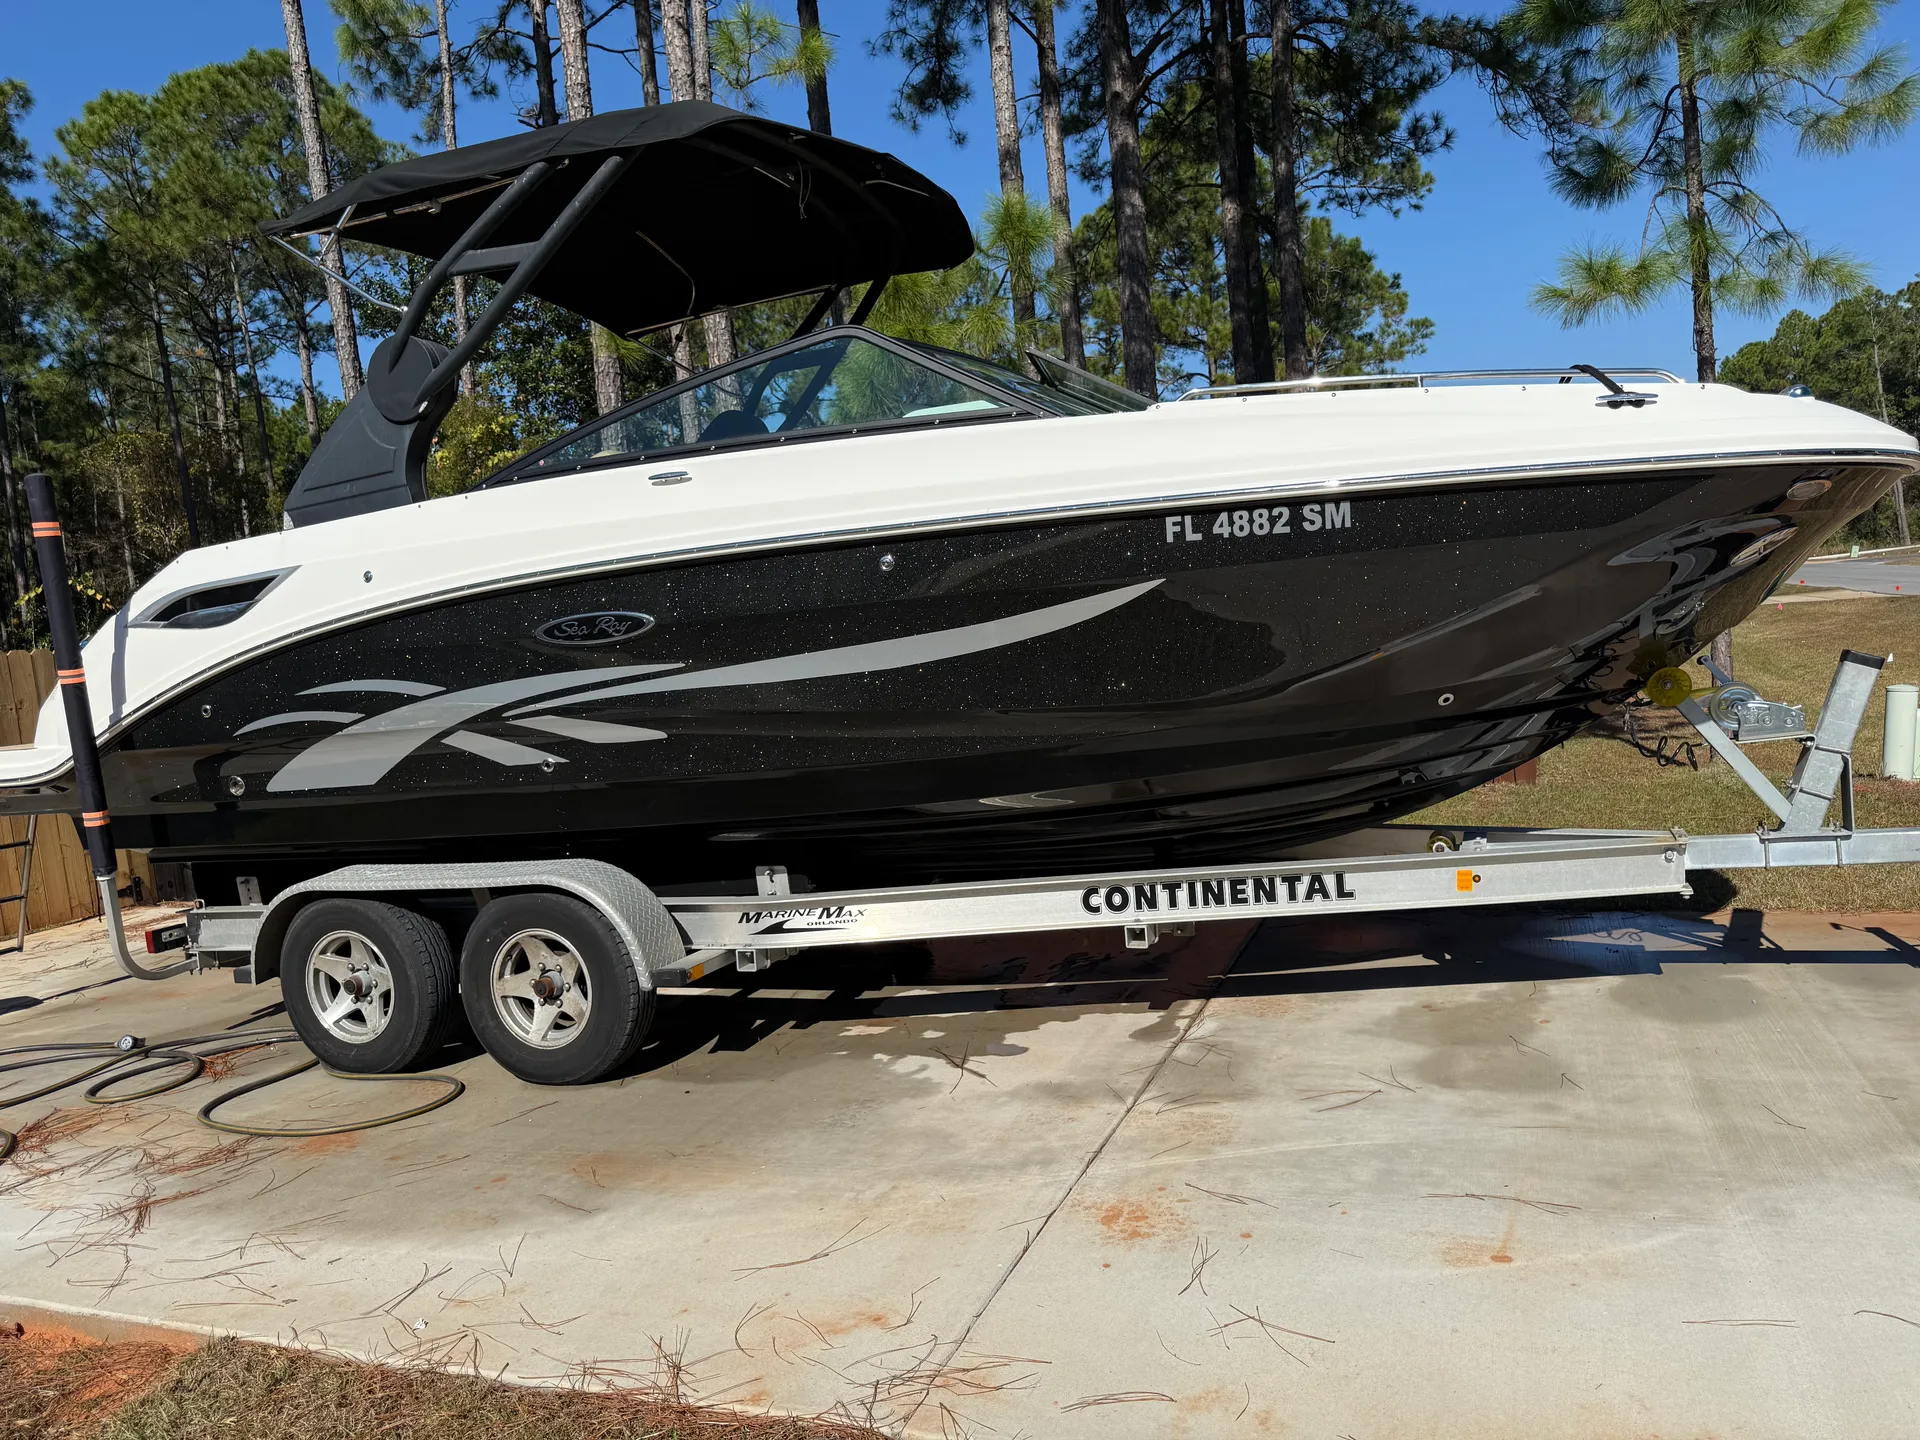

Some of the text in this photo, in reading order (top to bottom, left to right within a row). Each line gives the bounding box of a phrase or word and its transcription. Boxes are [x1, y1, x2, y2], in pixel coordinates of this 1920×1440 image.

[1165, 500, 1351, 543] FL 4882 SM
[554, 616, 632, 636] Sea Ray
[1080, 871, 1356, 915] CONTINENTAL
[806, 918, 858, 927] ORLANDO
